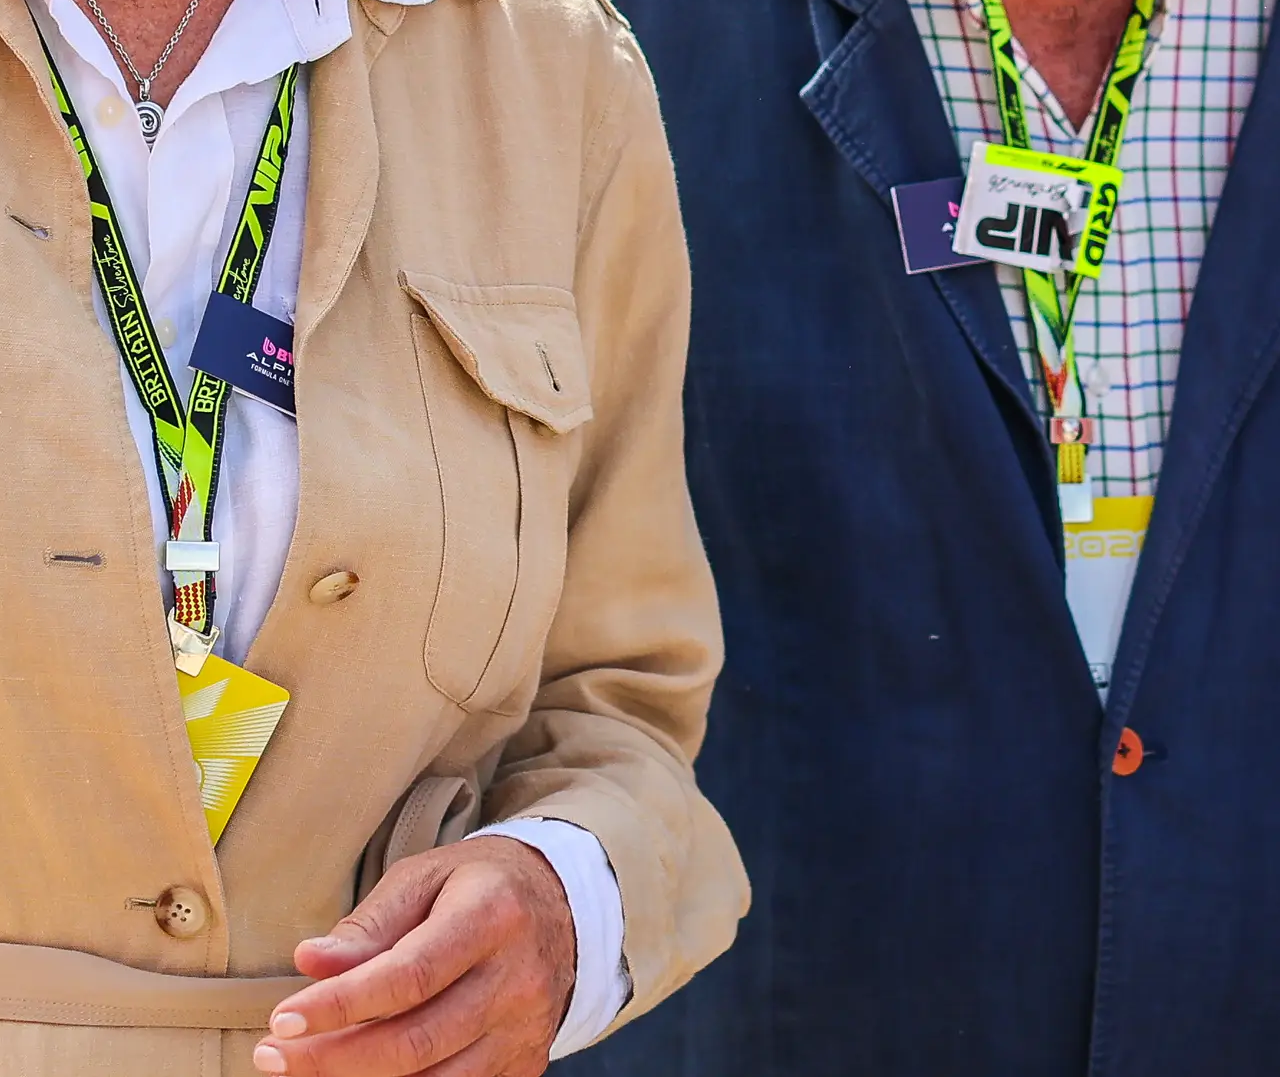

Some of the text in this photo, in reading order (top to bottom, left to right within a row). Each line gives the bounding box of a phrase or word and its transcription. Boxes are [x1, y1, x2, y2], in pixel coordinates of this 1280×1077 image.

[248, 124, 282, 205] VIP
[975, 201, 1074, 262] VIP
[1084, 182, 1119, 267] GRID
[228, 257, 251, 300] erstone
[98, 233, 168, 407] BRITAIN Silverstone
[246, 352, 292, 377] ALPI
[251, 363, 277, 381] FORMULA
